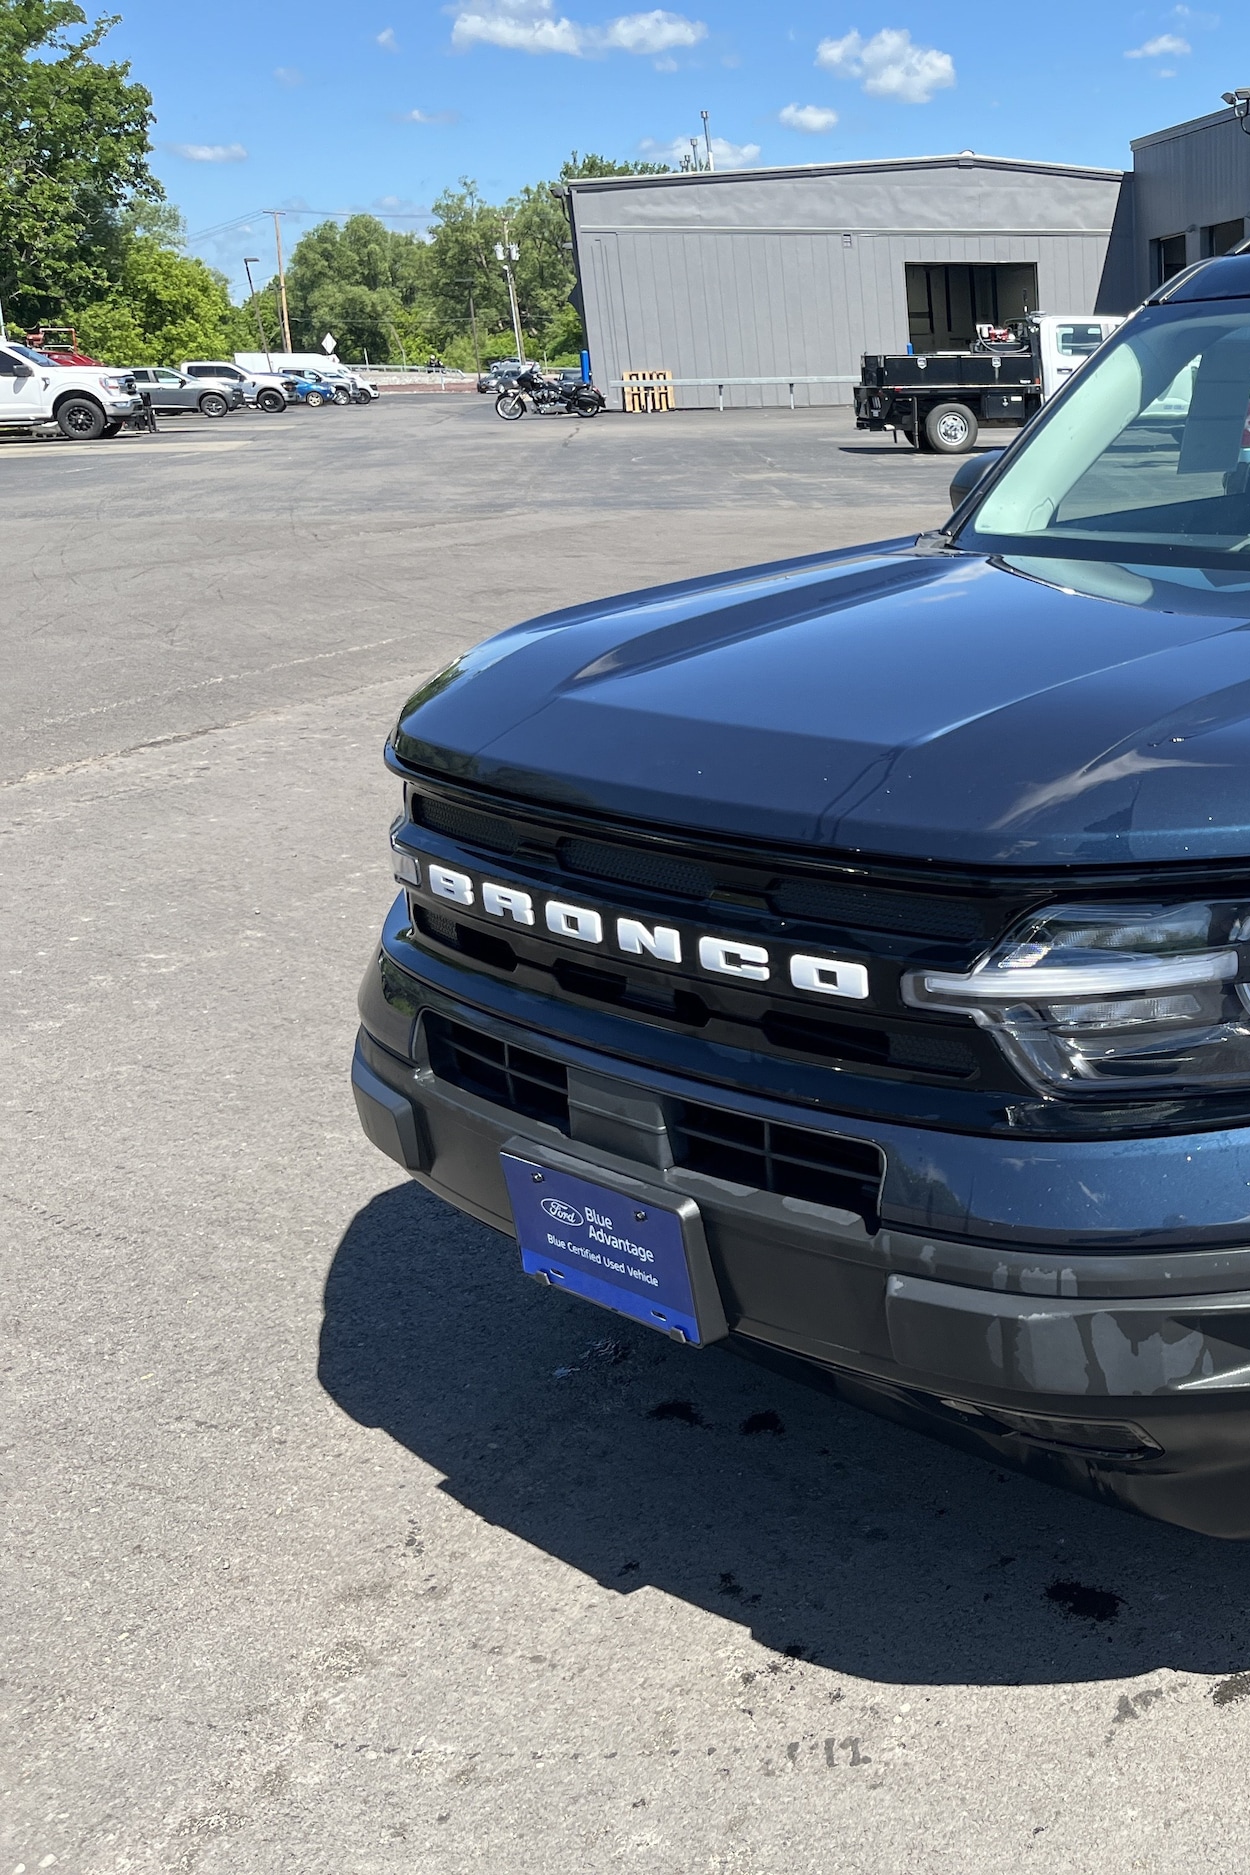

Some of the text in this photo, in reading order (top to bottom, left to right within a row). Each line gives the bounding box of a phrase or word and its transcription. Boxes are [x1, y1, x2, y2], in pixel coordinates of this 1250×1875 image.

[428, 864, 870, 1000] BRONCO
[548, 1200, 577, 1225] Ford
[584, 1206, 613, 1231] Blue
[547, 1233, 659, 1287] Blue Certified Used Vehicle
[588, 1225, 655, 1263] Advantage
